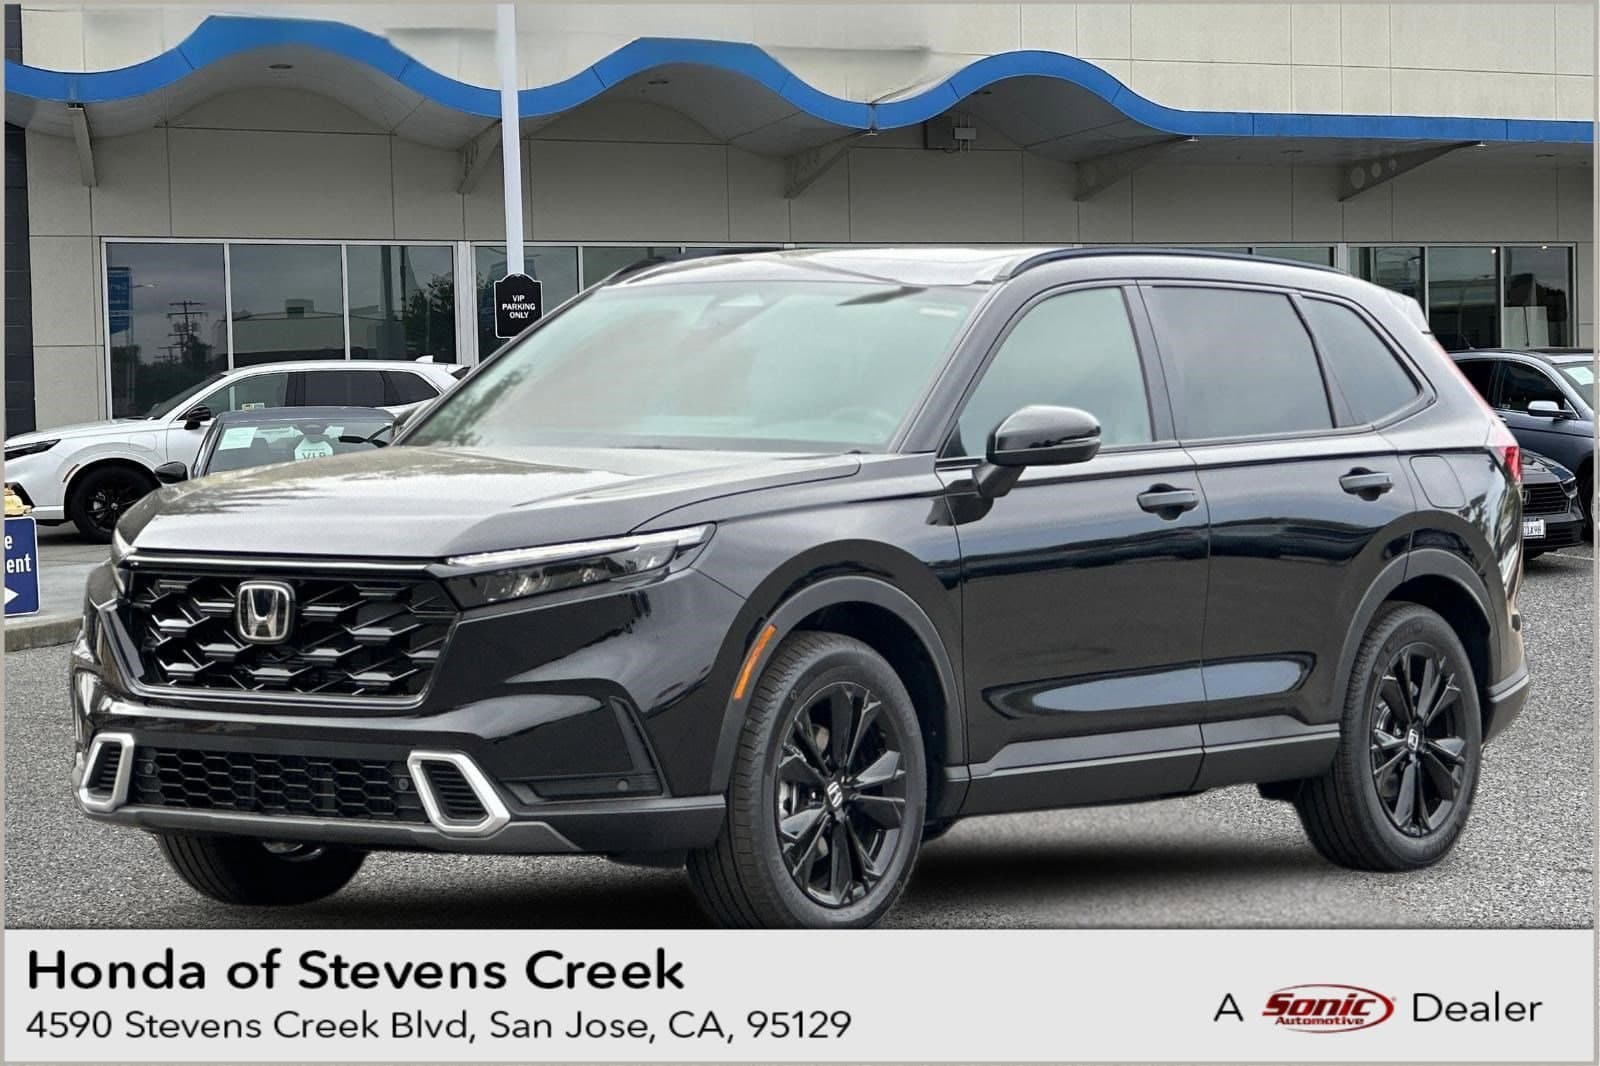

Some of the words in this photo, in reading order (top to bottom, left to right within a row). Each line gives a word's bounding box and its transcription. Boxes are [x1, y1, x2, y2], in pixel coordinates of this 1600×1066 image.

[502, 303, 536, 311] PARKING
[510, 311, 529, 319] ONLY
[6, 553, 32, 573] ent
